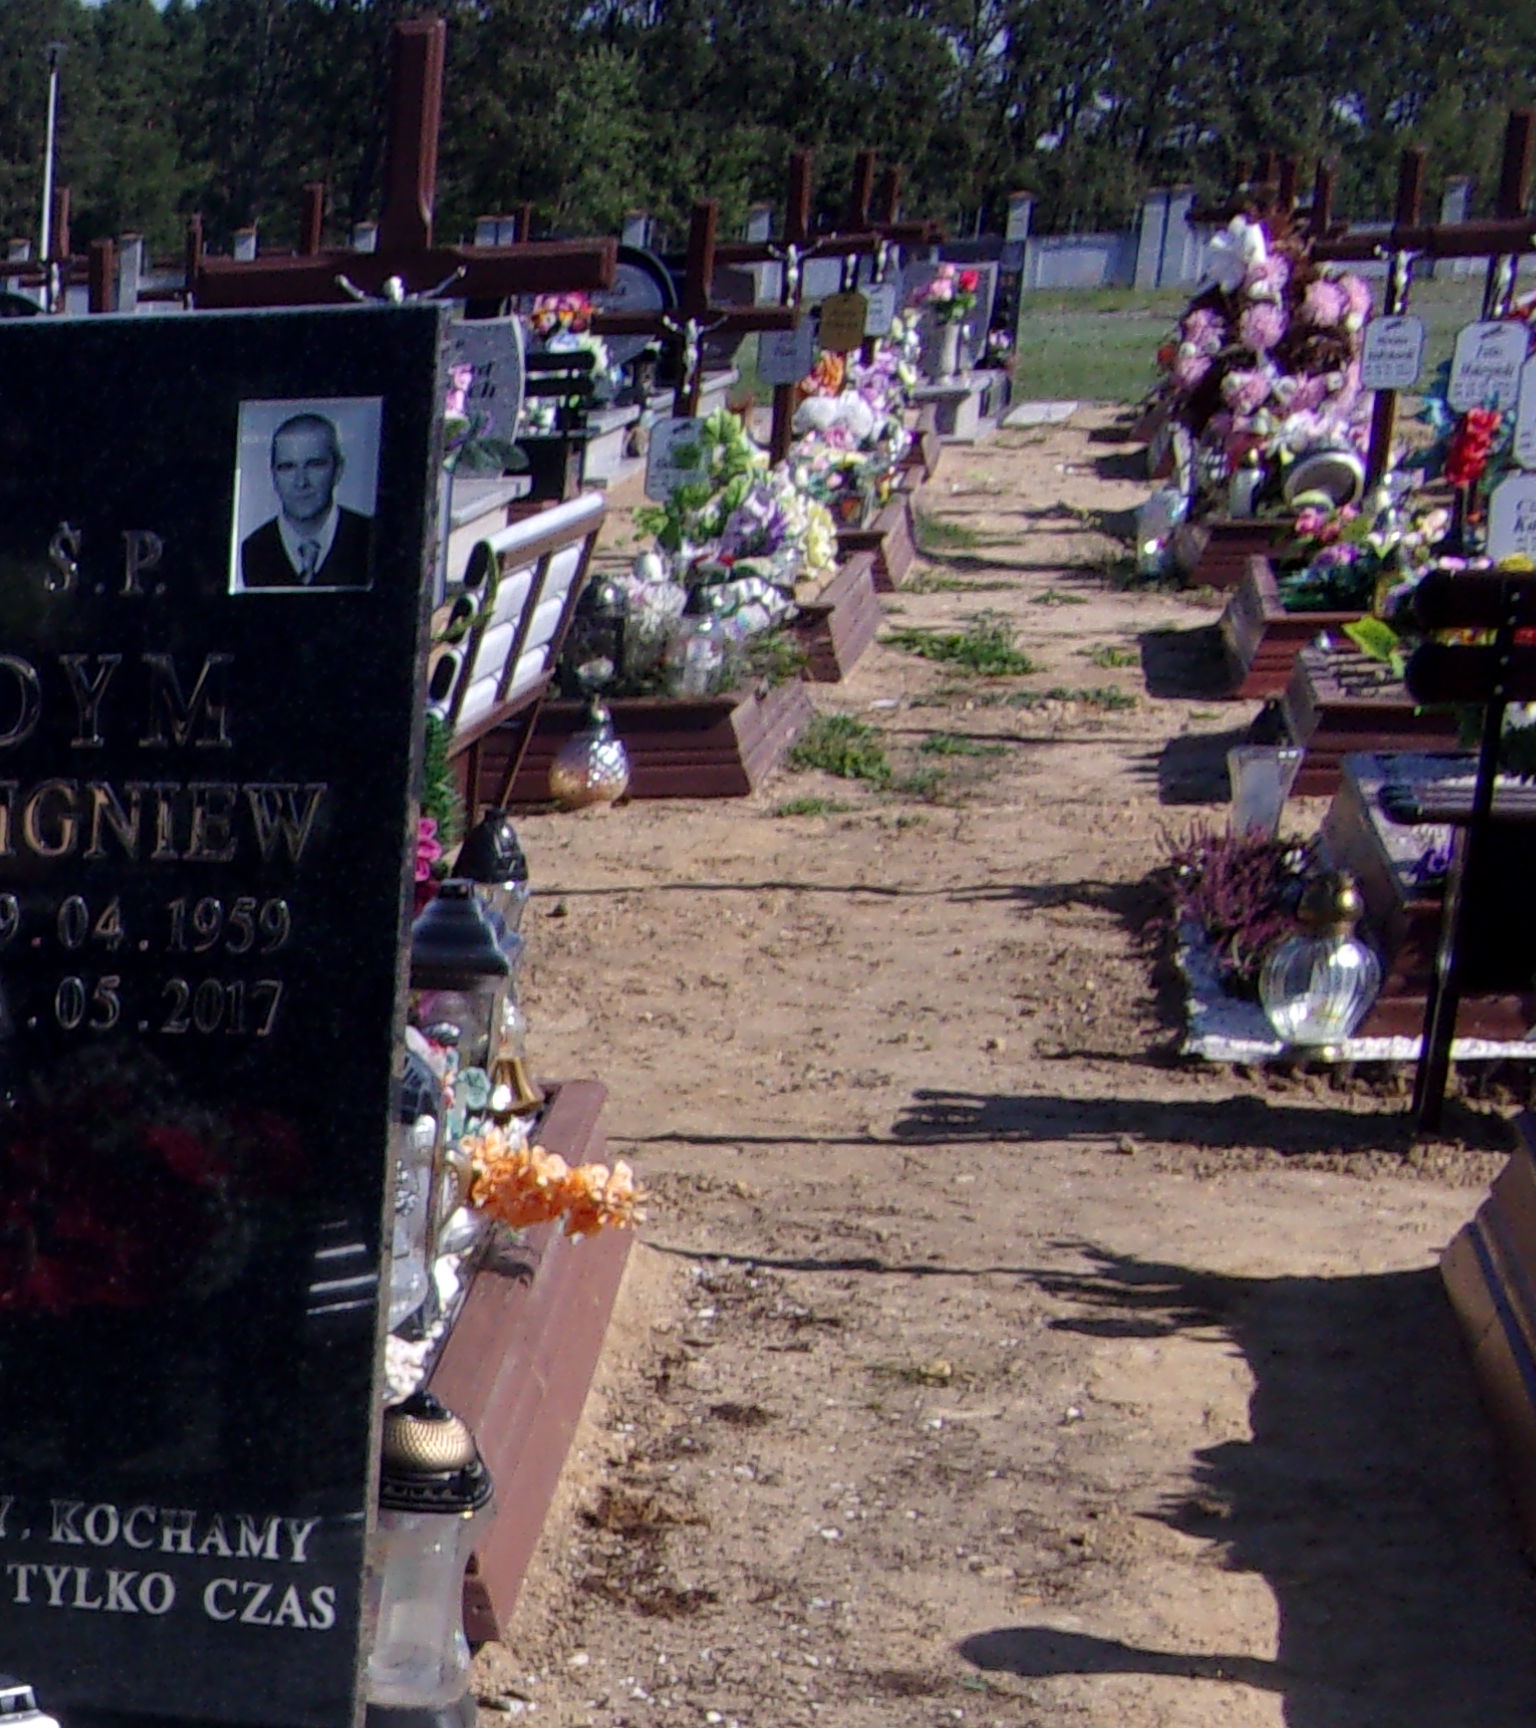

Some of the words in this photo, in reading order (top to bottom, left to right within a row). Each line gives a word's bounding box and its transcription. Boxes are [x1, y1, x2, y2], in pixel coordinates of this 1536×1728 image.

[47, 1497, 323, 1563] KOCHAMY
[6, 1561, 177, 1615] TYLKO
[202, 1577, 337, 1631] CZAS
